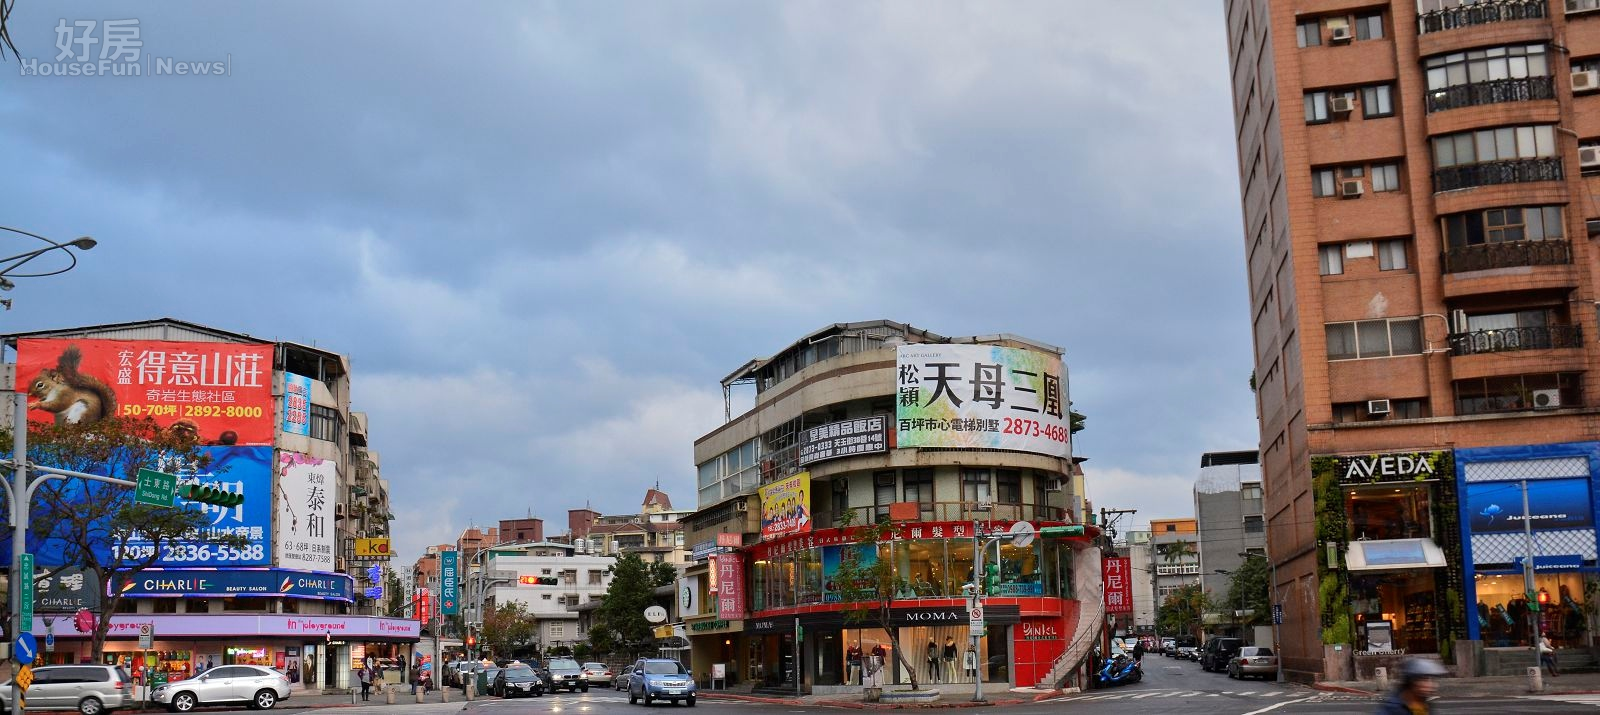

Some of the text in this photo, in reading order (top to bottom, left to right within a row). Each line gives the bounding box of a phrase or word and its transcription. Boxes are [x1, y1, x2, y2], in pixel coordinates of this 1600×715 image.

[117, 350, 134, 384] 宏盛
[136, 350, 264, 387] 得意山莊
[146, 389, 236, 403] 奇岩生態社區
[922, 362, 1063, 420] 天母三凰
[123, 404, 263, 418] 50-70坪 2892-8000
[899, 417, 1068, 444] 百坪市心電梯別墅 2873-4688
[1345, 456, 1434, 478] AVEDA
[142, 490, 160, 500] ShiDong
[306, 486, 325, 538] 泰和
[163, 544, 264, 561] 2836-5588
[144, 578, 207, 591] CHARLIE
[298, 578, 336, 590] CHARLIE
[720, 564, 735, 612] 丹尼爾
[1106, 559, 1123, 605] 丹尼爾
[42, 598, 83, 606] CHARLIE
[906, 612, 958, 621] MOMA
